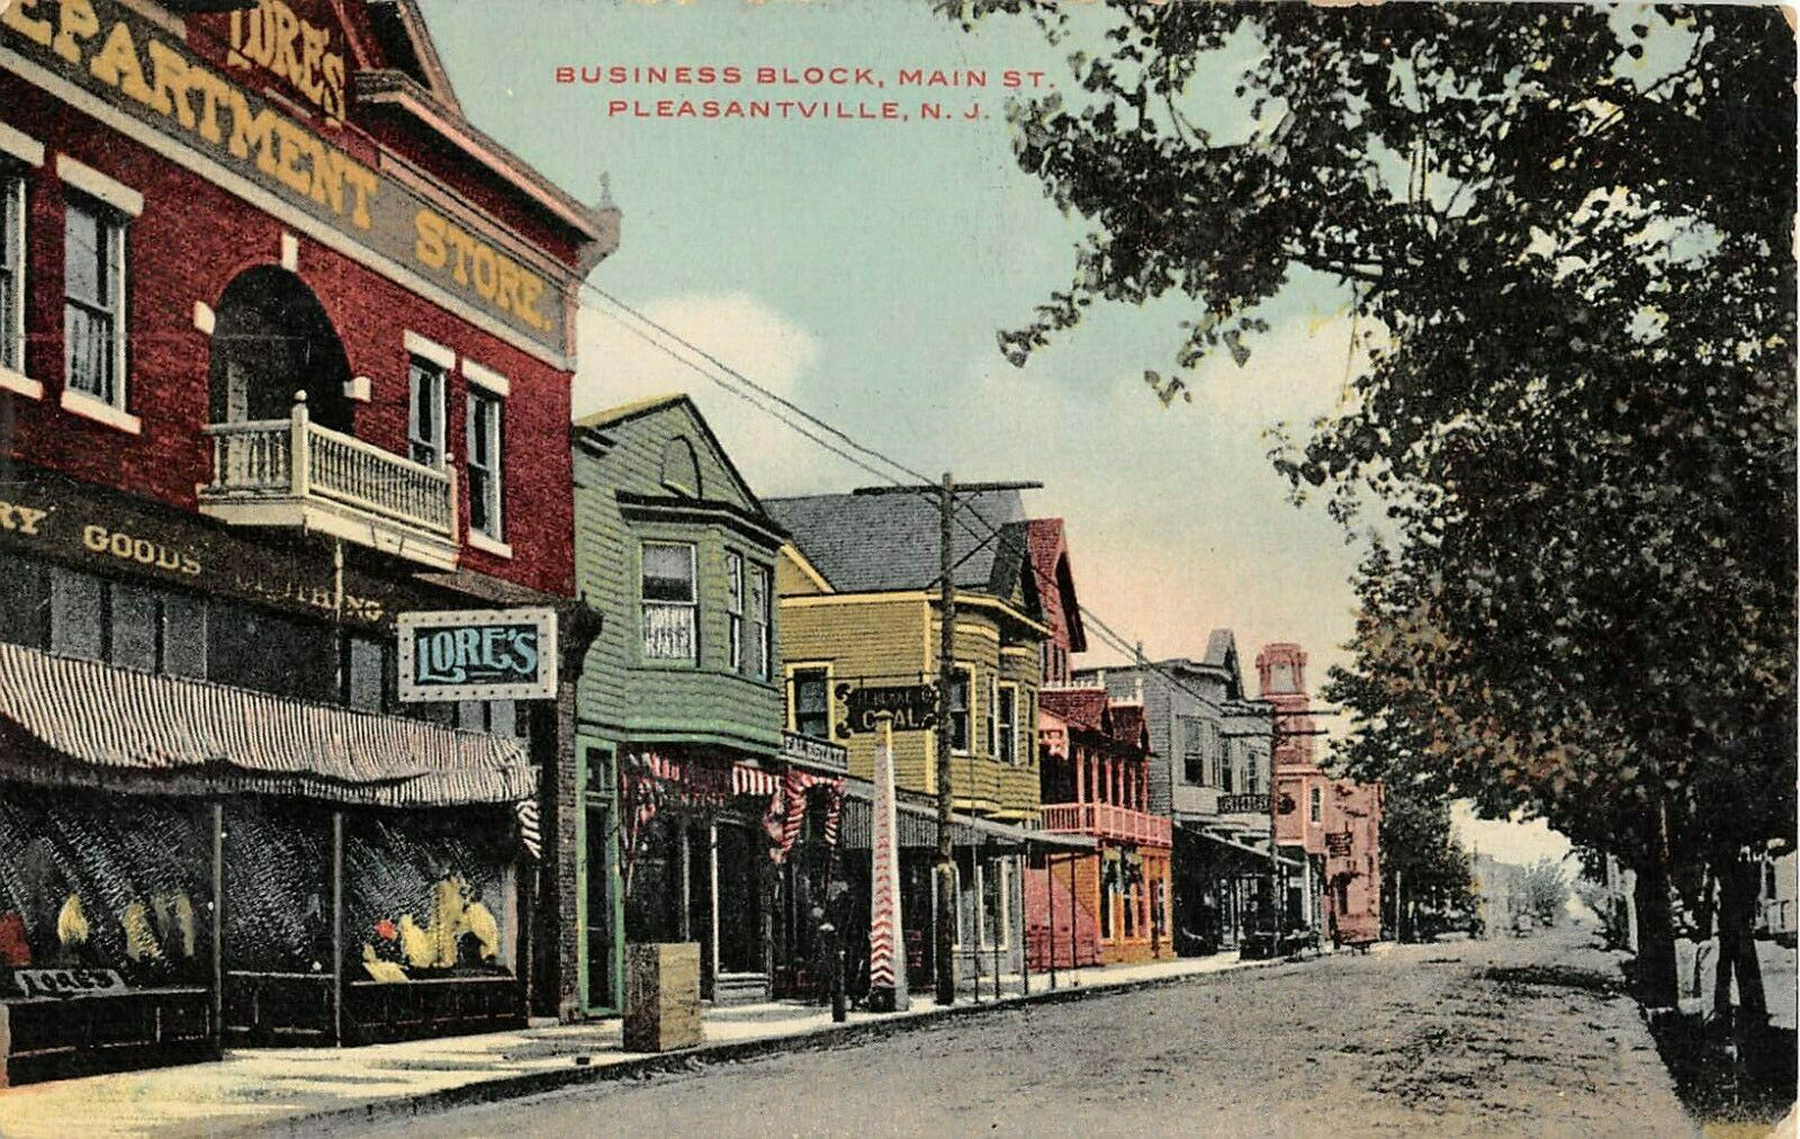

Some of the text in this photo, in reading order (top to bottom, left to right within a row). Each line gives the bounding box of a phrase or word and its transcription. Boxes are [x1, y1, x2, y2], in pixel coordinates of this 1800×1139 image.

[414, 208, 553, 332] STORE.
[83, 525, 201, 575] GOODS
[418, 627, 537, 683] LORE'S
[862, 707, 919, 730] CAL
